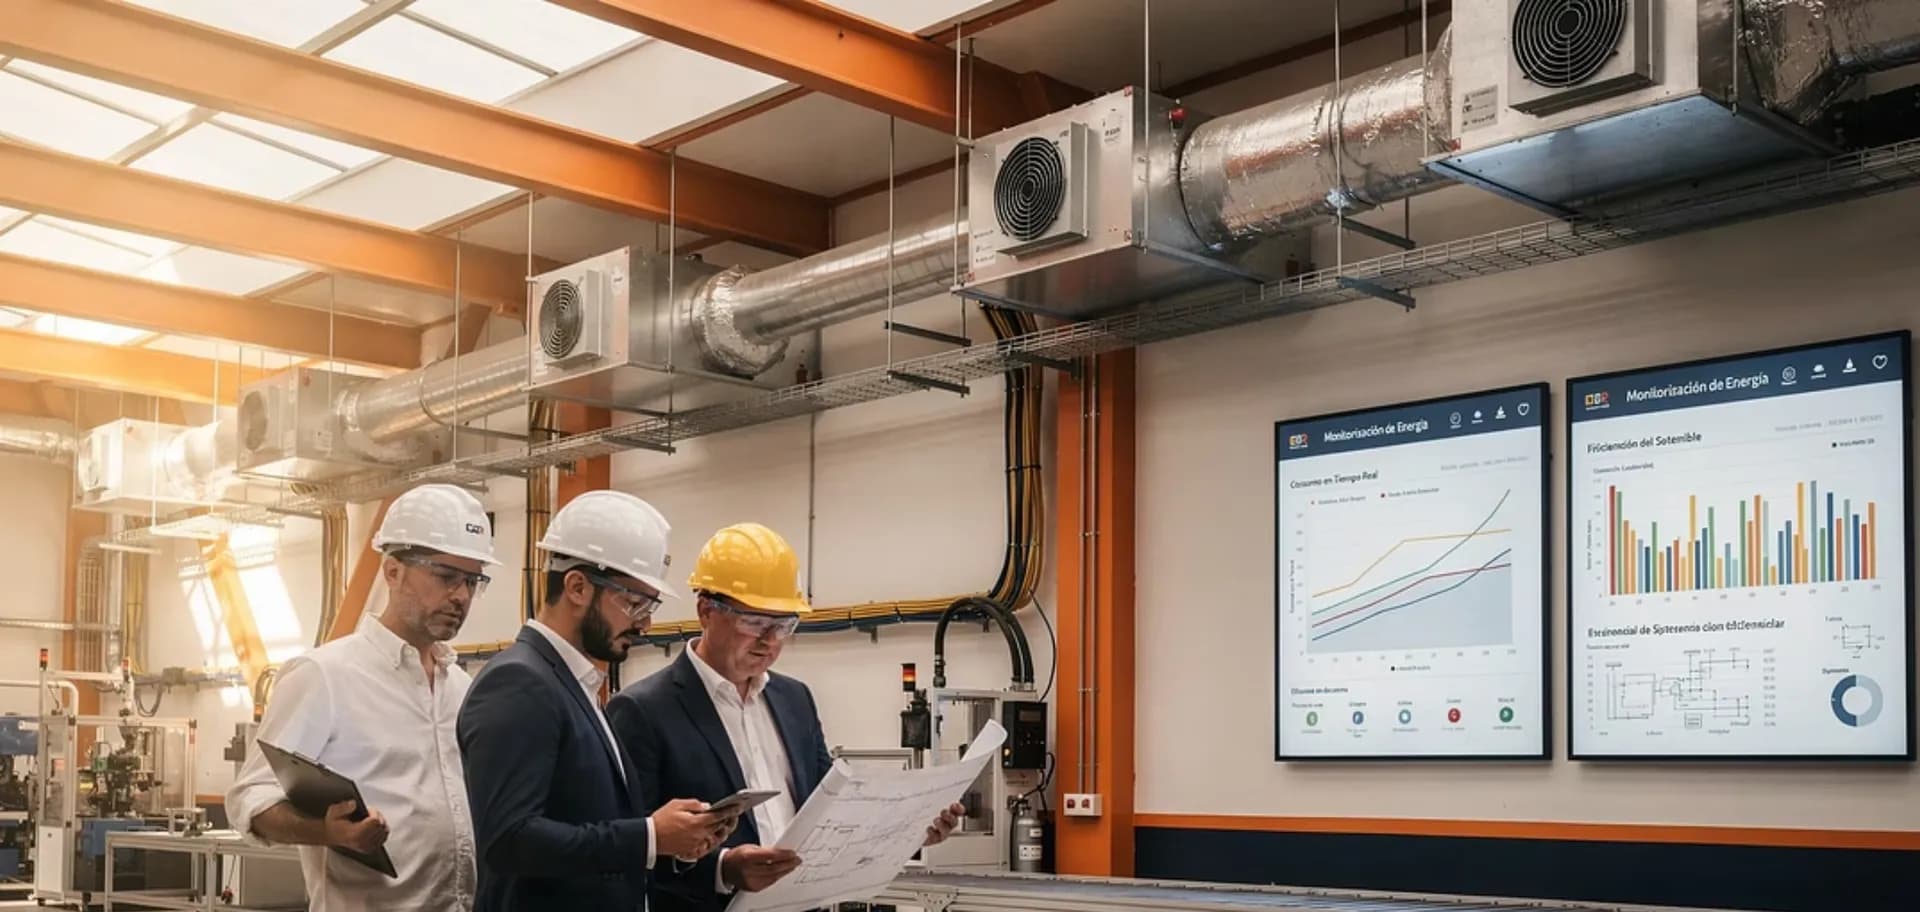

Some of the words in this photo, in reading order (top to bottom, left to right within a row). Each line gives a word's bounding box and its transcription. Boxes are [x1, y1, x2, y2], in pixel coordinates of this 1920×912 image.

[1709, 379, 1723, 392] de
[1725, 372, 1769, 389] Energía
[1640, 438, 1653, 447] del
[1640, 625, 1651, 635] de
